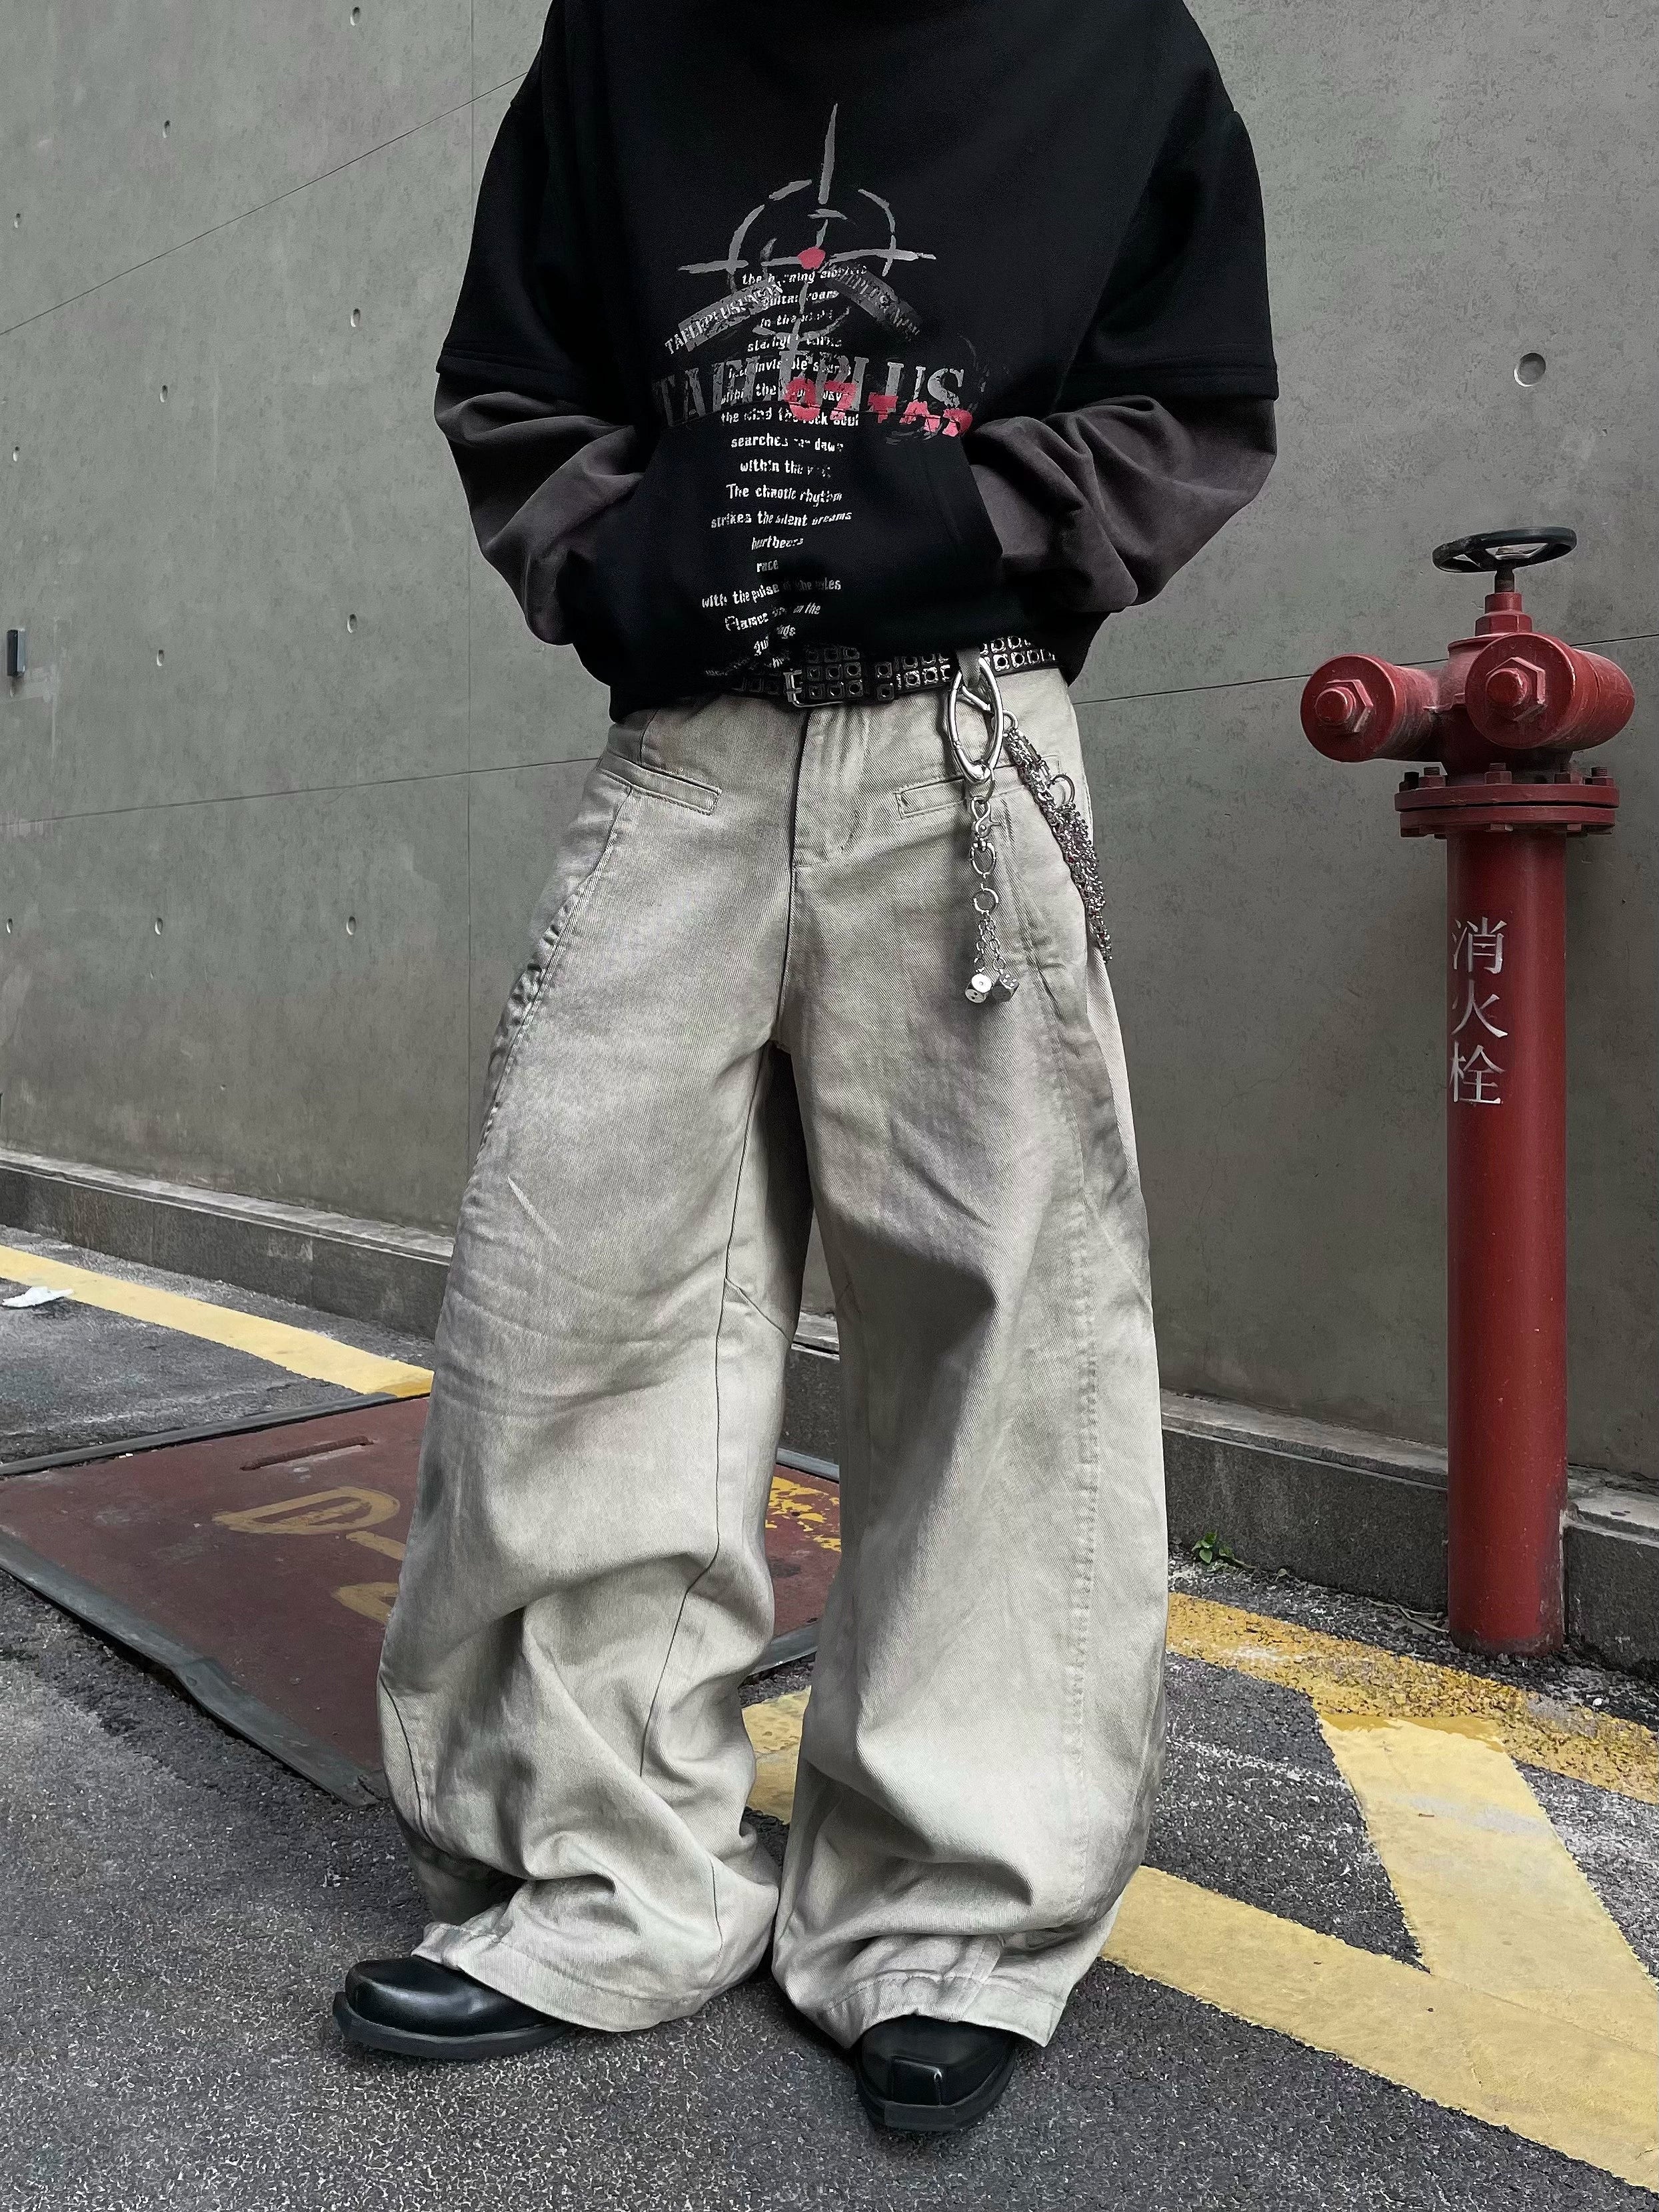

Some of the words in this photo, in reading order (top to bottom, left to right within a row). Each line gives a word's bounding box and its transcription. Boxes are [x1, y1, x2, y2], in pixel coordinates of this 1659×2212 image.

[742, 273, 762, 285] the
[755, 358, 808, 374] invisble
[721, 411, 740, 424] the
[731, 433, 789, 448] searches
[740, 459, 780, 473] within
[726, 483, 750, 499] The
[711, 511, 752, 529] strikes
[757, 511, 774, 525] the
[756, 559, 779, 573] race
[702, 593, 728, 608] with
[733, 589, 751, 605] the
[1449, 916, 1508, 1106] 消火栓
